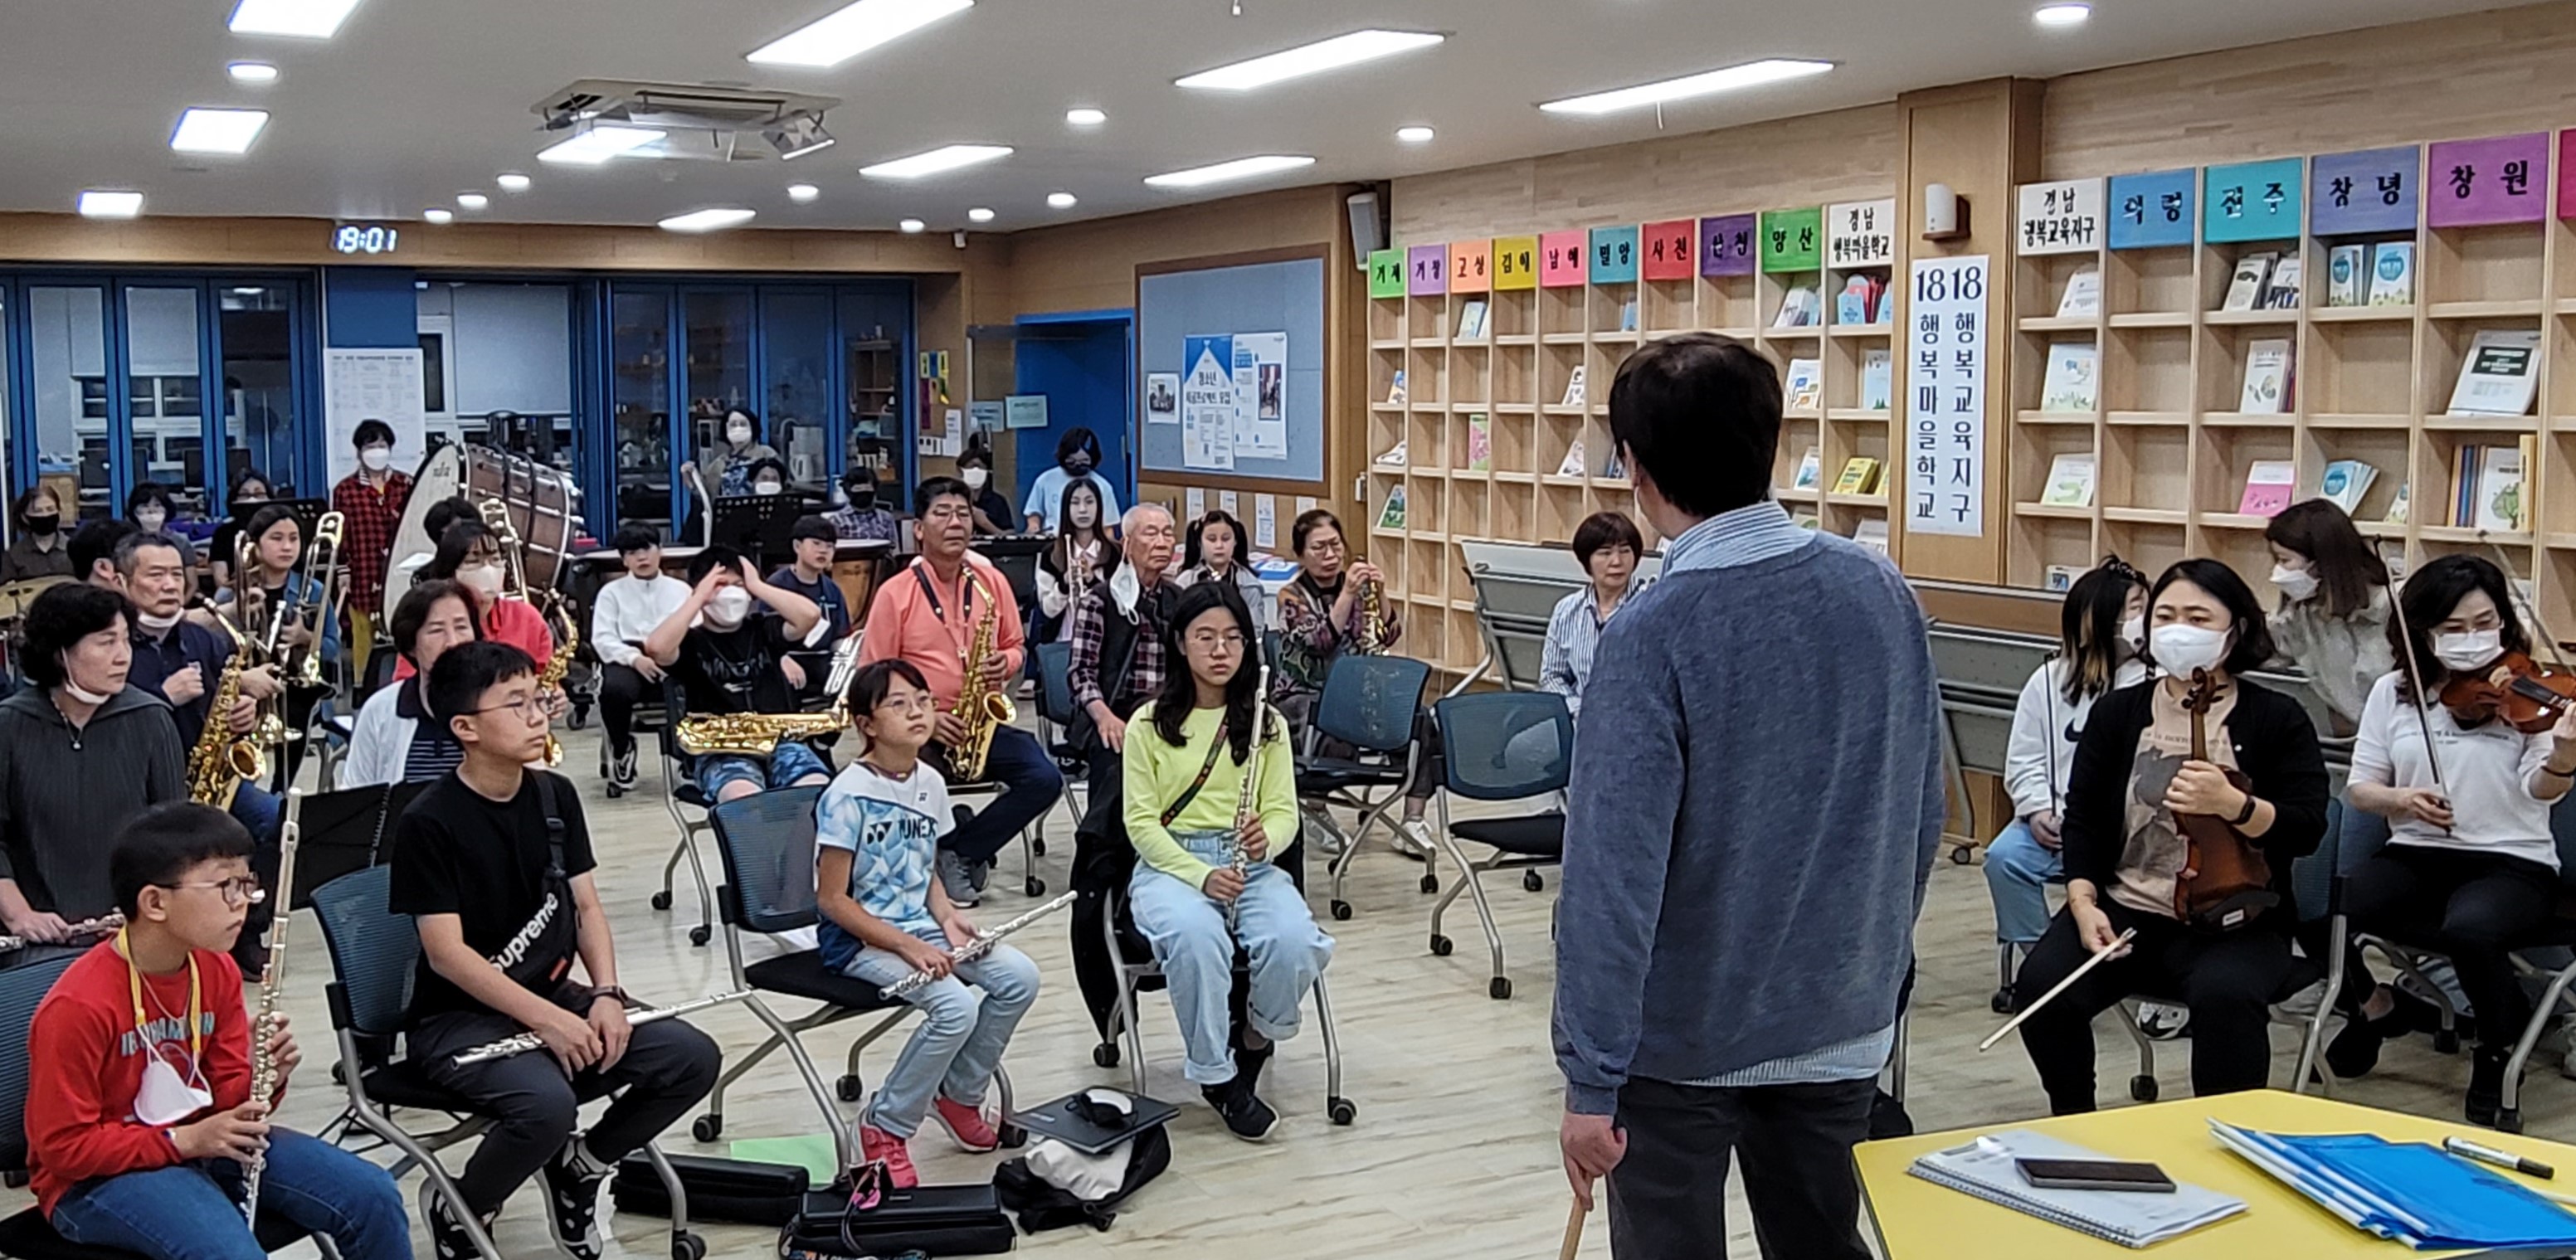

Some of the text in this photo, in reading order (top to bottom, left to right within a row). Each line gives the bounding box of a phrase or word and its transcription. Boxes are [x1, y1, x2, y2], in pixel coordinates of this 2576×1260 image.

[2328, 172, 2402, 208] 창녕
[2448, 159, 2529, 199] 창원
[2043, 187, 2077, 216] 경남
[2122, 191, 2183, 226] 의령
[1848, 207, 1874, 232] 경남
[2023, 216, 2096, 248] 행복교육지구
[338, 226, 397, 255] 19:01
[1599, 241, 1631, 266] 밀양
[1652, 236, 1687, 262] 사천
[1712, 231, 1749, 260] 산청
[1771, 226, 1814, 253] 양산
[1833, 234, 1890, 262] 행복마을학교
[1376, 262, 1401, 284] 거제
[1415, 259, 1441, 280] 거창
[1457, 254, 1485, 278] 고성
[1916, 268, 1946, 519] 18 행복마을학교
[1950, 265, 1983, 523] 18 행복교육지구
